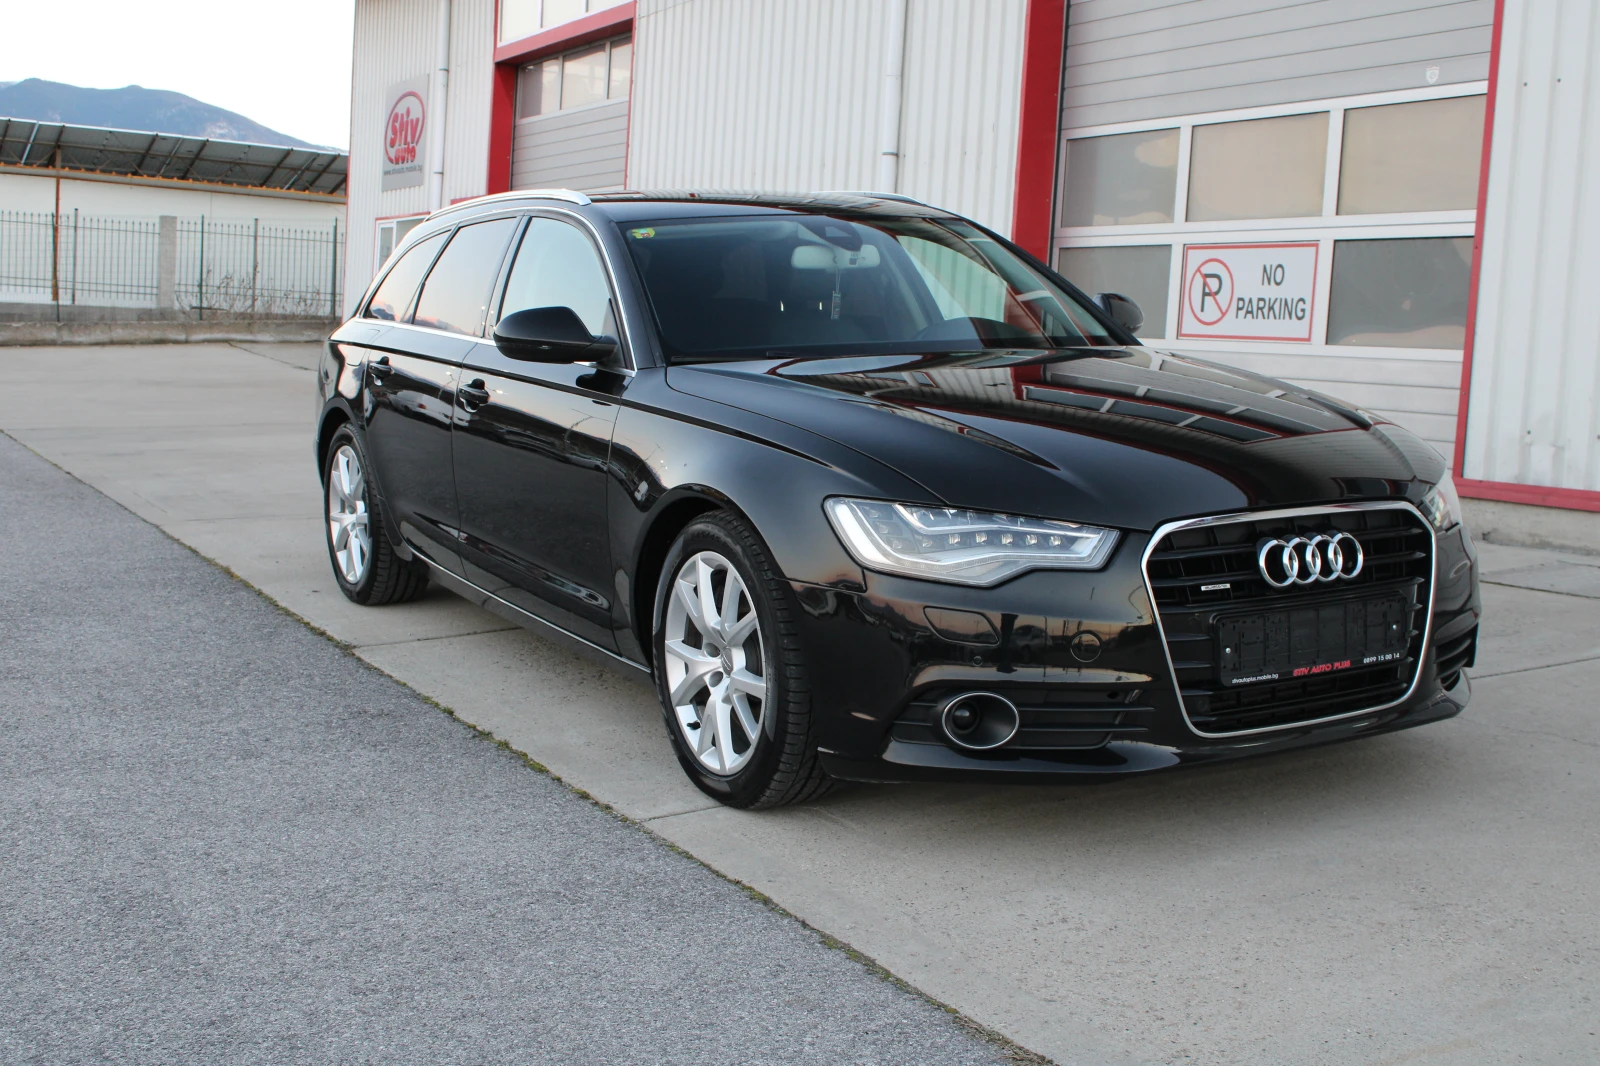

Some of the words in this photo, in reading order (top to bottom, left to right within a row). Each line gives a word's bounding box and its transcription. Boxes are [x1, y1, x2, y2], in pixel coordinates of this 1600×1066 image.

[389, 107, 420, 148] Stiv
[394, 142, 417, 165] auto
[1261, 264, 1285, 286] NO
[1200, 273, 1223, 313] P
[1236, 297, 1306, 321] PARKING
[1293, 667, 1310, 676] STIV
[1311, 663, 1332, 673] AUTO
[1333, 659, 1351, 669] PLUS
